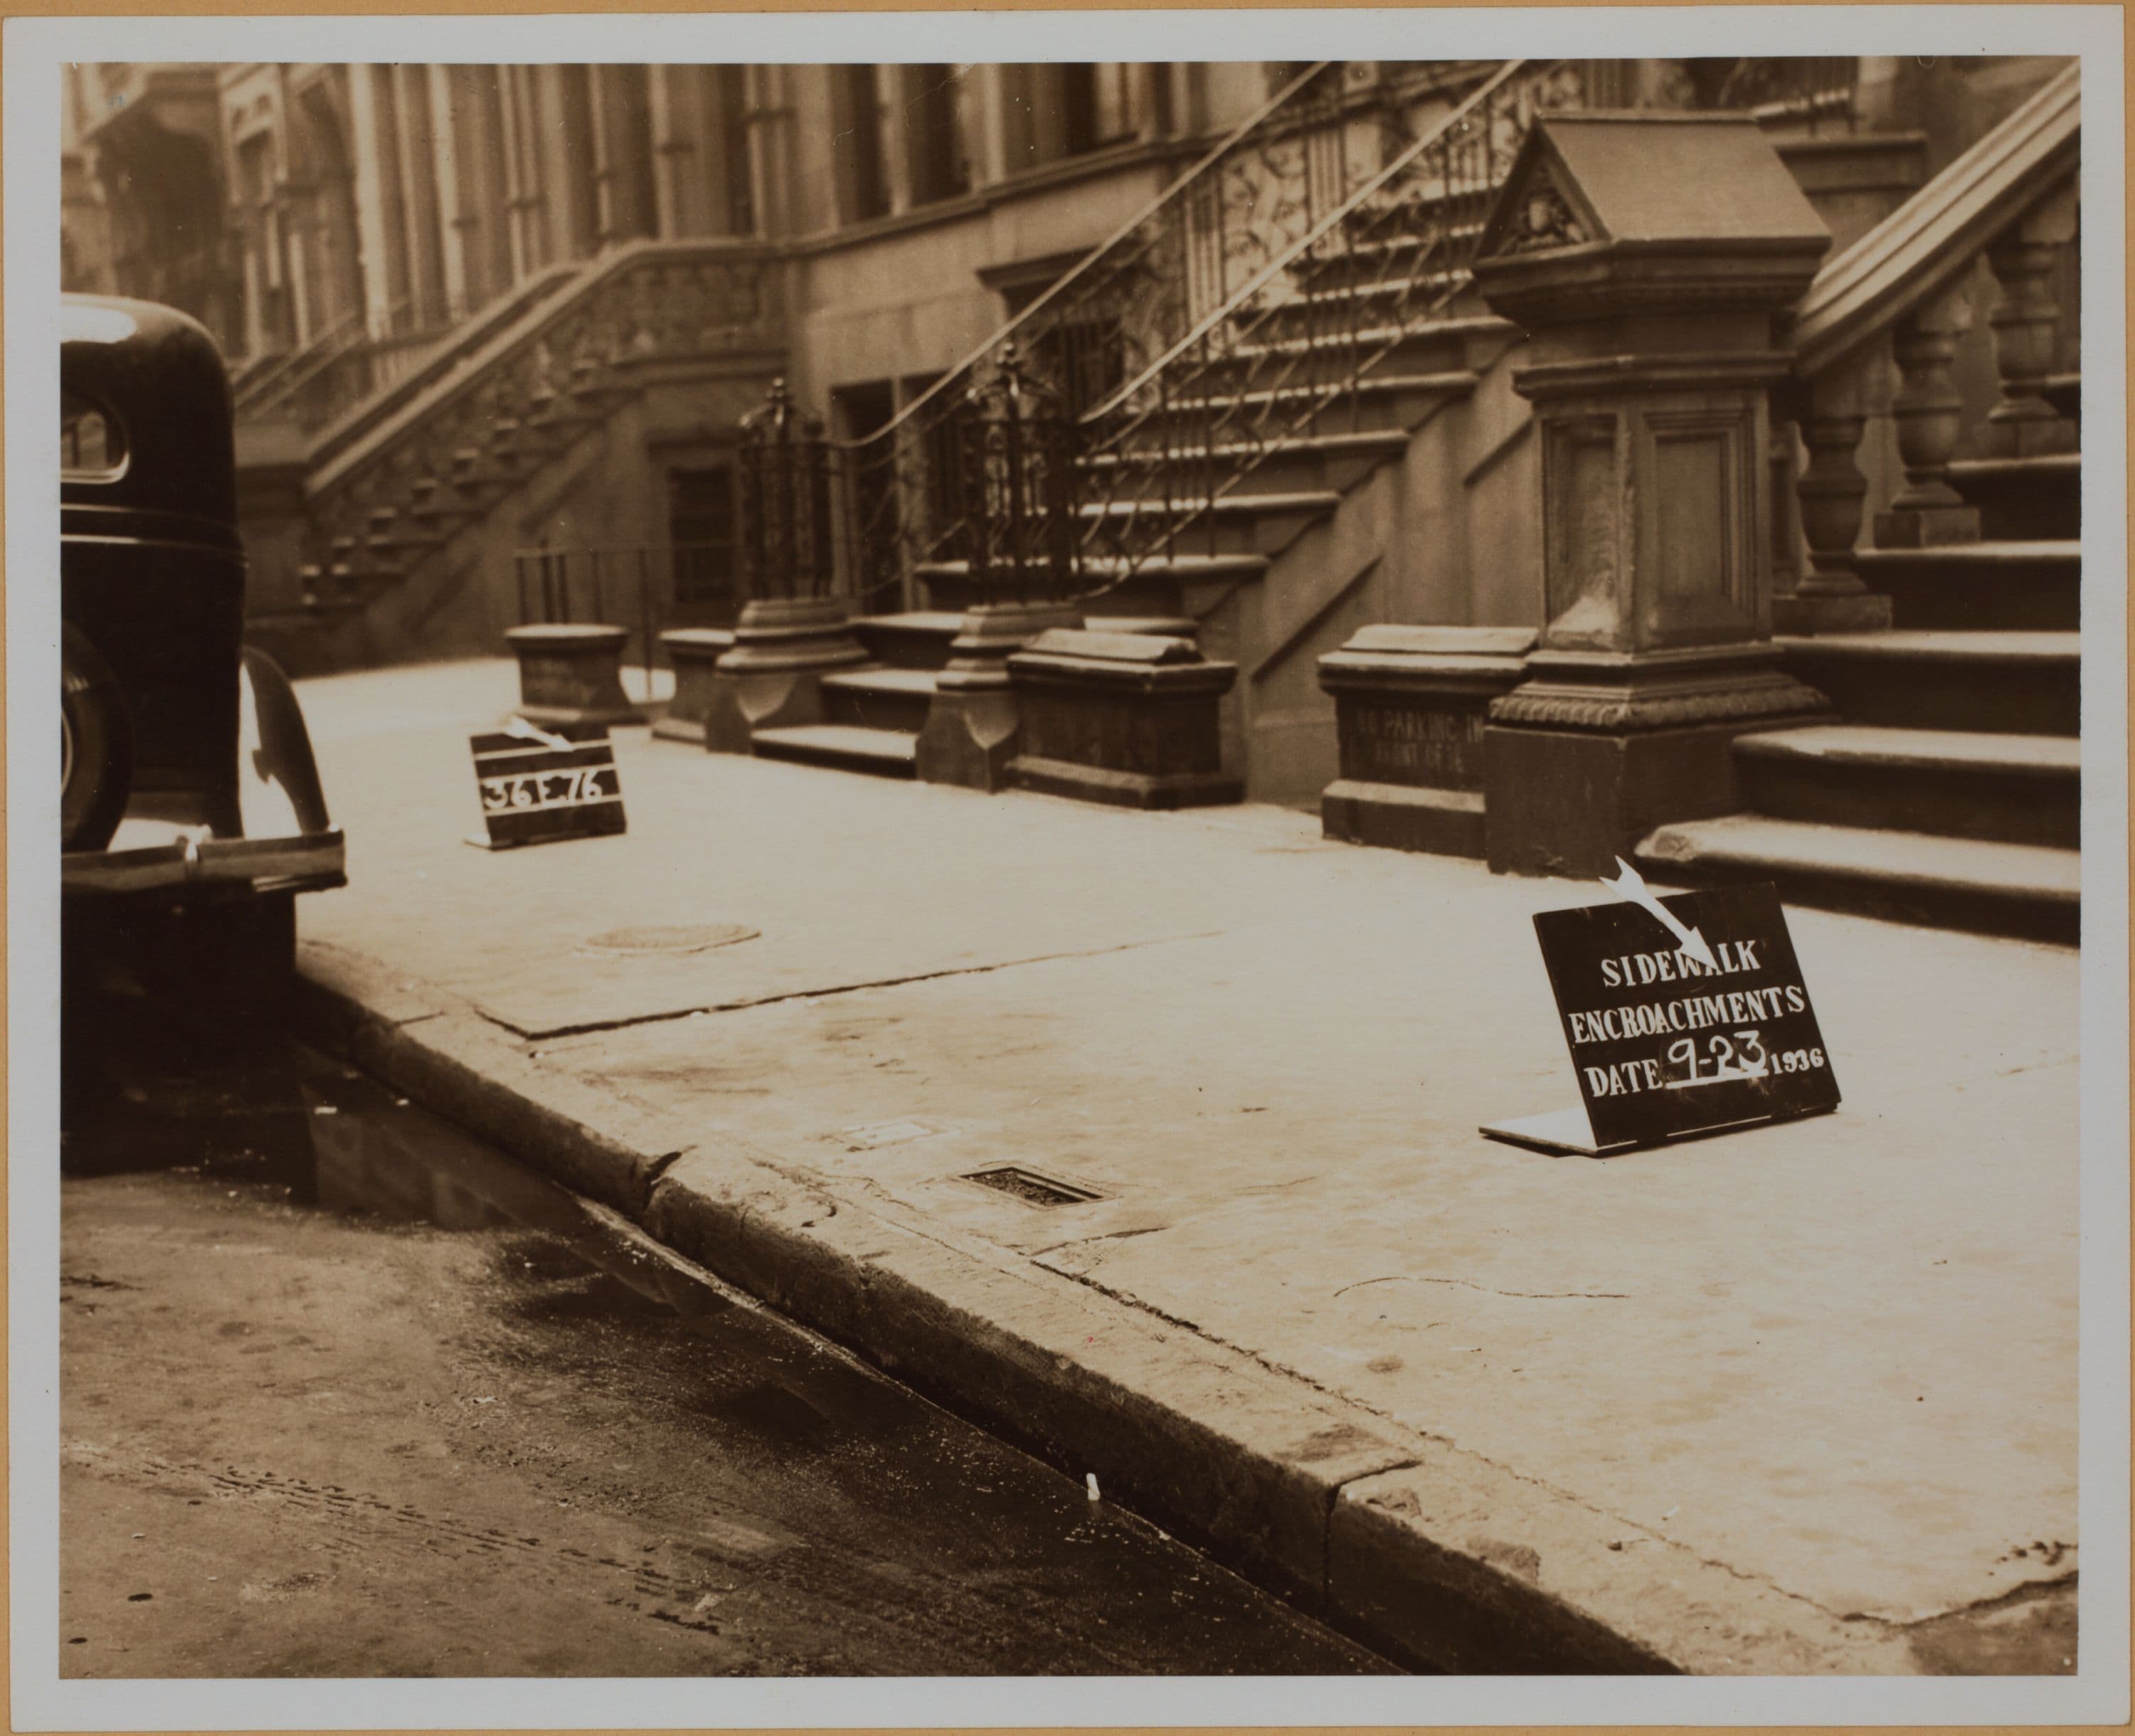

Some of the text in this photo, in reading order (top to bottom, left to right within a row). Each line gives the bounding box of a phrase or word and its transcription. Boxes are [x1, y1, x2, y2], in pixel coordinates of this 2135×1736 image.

[1568, 985, 1805, 1043] ENCROACHMENTS
[1584, 1030, 1824, 1096] DATE 9-23 1936
